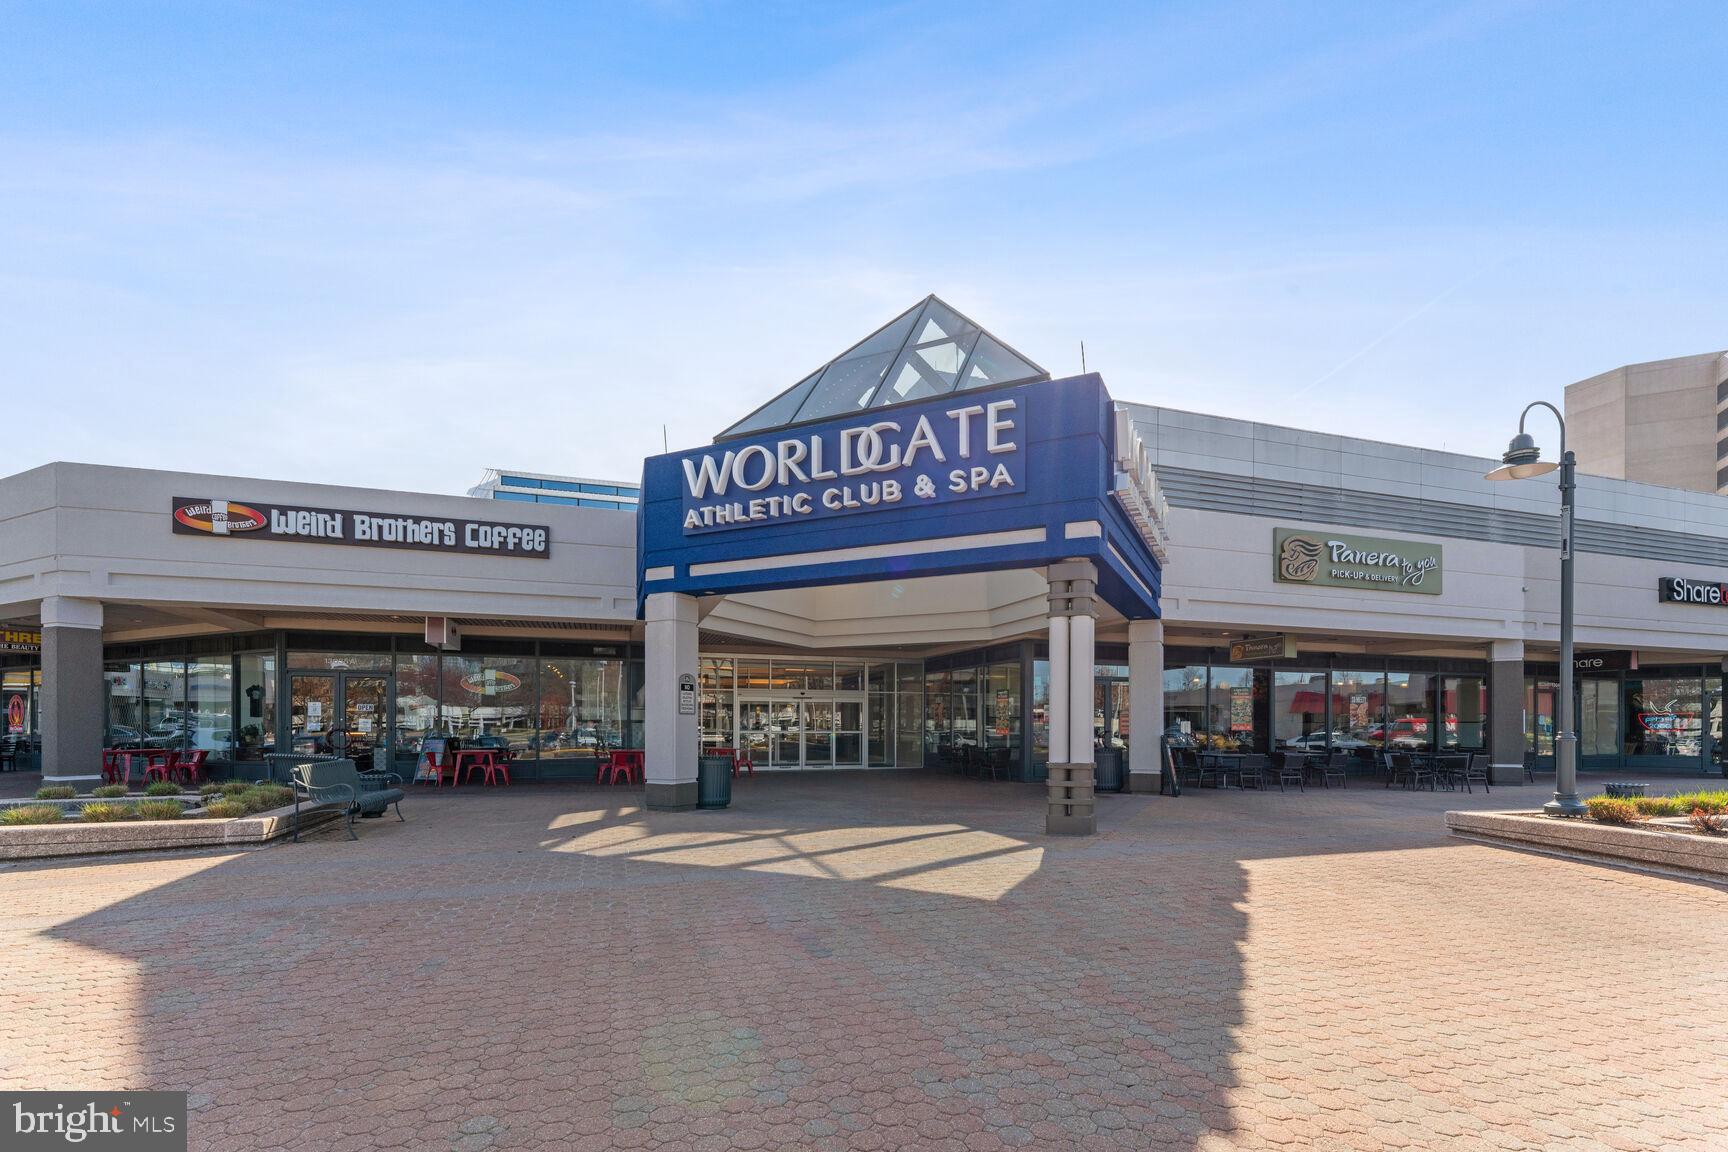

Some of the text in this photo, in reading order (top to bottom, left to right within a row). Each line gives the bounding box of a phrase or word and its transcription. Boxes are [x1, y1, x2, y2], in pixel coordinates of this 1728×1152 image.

[682, 399, 1017, 499] WORLDGATE
[683, 463, 1014, 528] ATHLETIC CLUB & SPA
[270, 508, 546, 552] Weird Brothers Coffee
[1327, 540, 1438, 586] Panera to you
[1331, 569, 1364, 579] PICK-UP
[1371, 574, 1399, 583] DELIVERY
